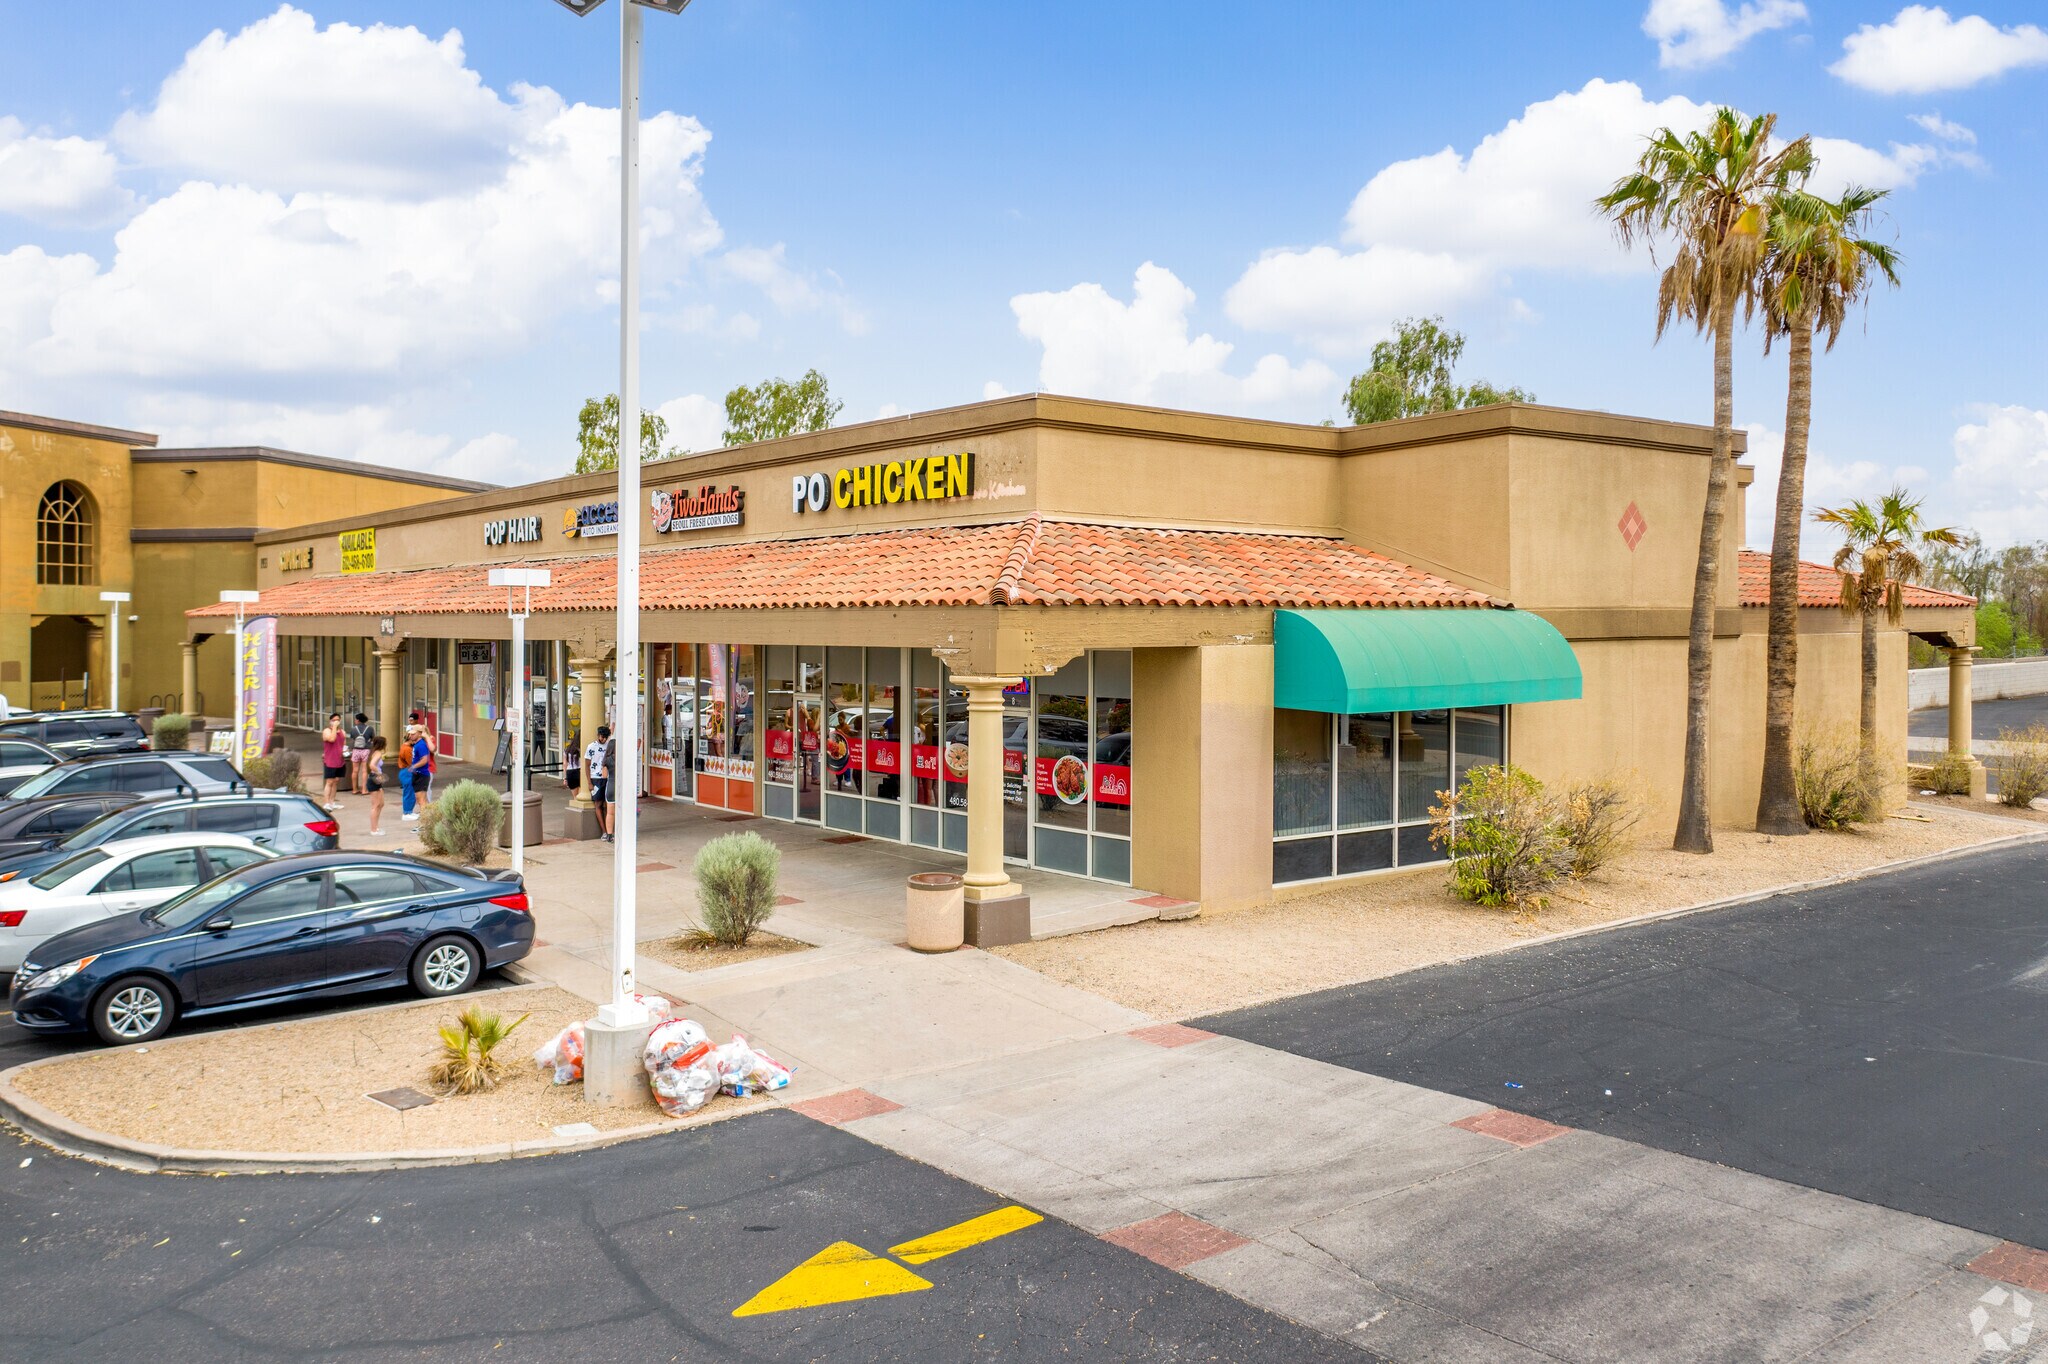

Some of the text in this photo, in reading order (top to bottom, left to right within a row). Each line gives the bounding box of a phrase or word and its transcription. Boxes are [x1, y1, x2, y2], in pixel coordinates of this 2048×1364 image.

[792, 452, 969, 514] PO CHICKEN
[581, 502, 618, 525] acces
[672, 514, 738, 530] SEOUL FRESH CORN DOGS
[484, 516, 540, 545] POP HAIR
[583, 523, 618, 536] AUTO INSURANC
[341, 531, 373, 553] AVAILABLE
[461, 650, 489, 661] 미용실
[267, 621, 275, 720] HAIRCUTS PERMS
[242, 632, 262, 760] HAIR SALO
